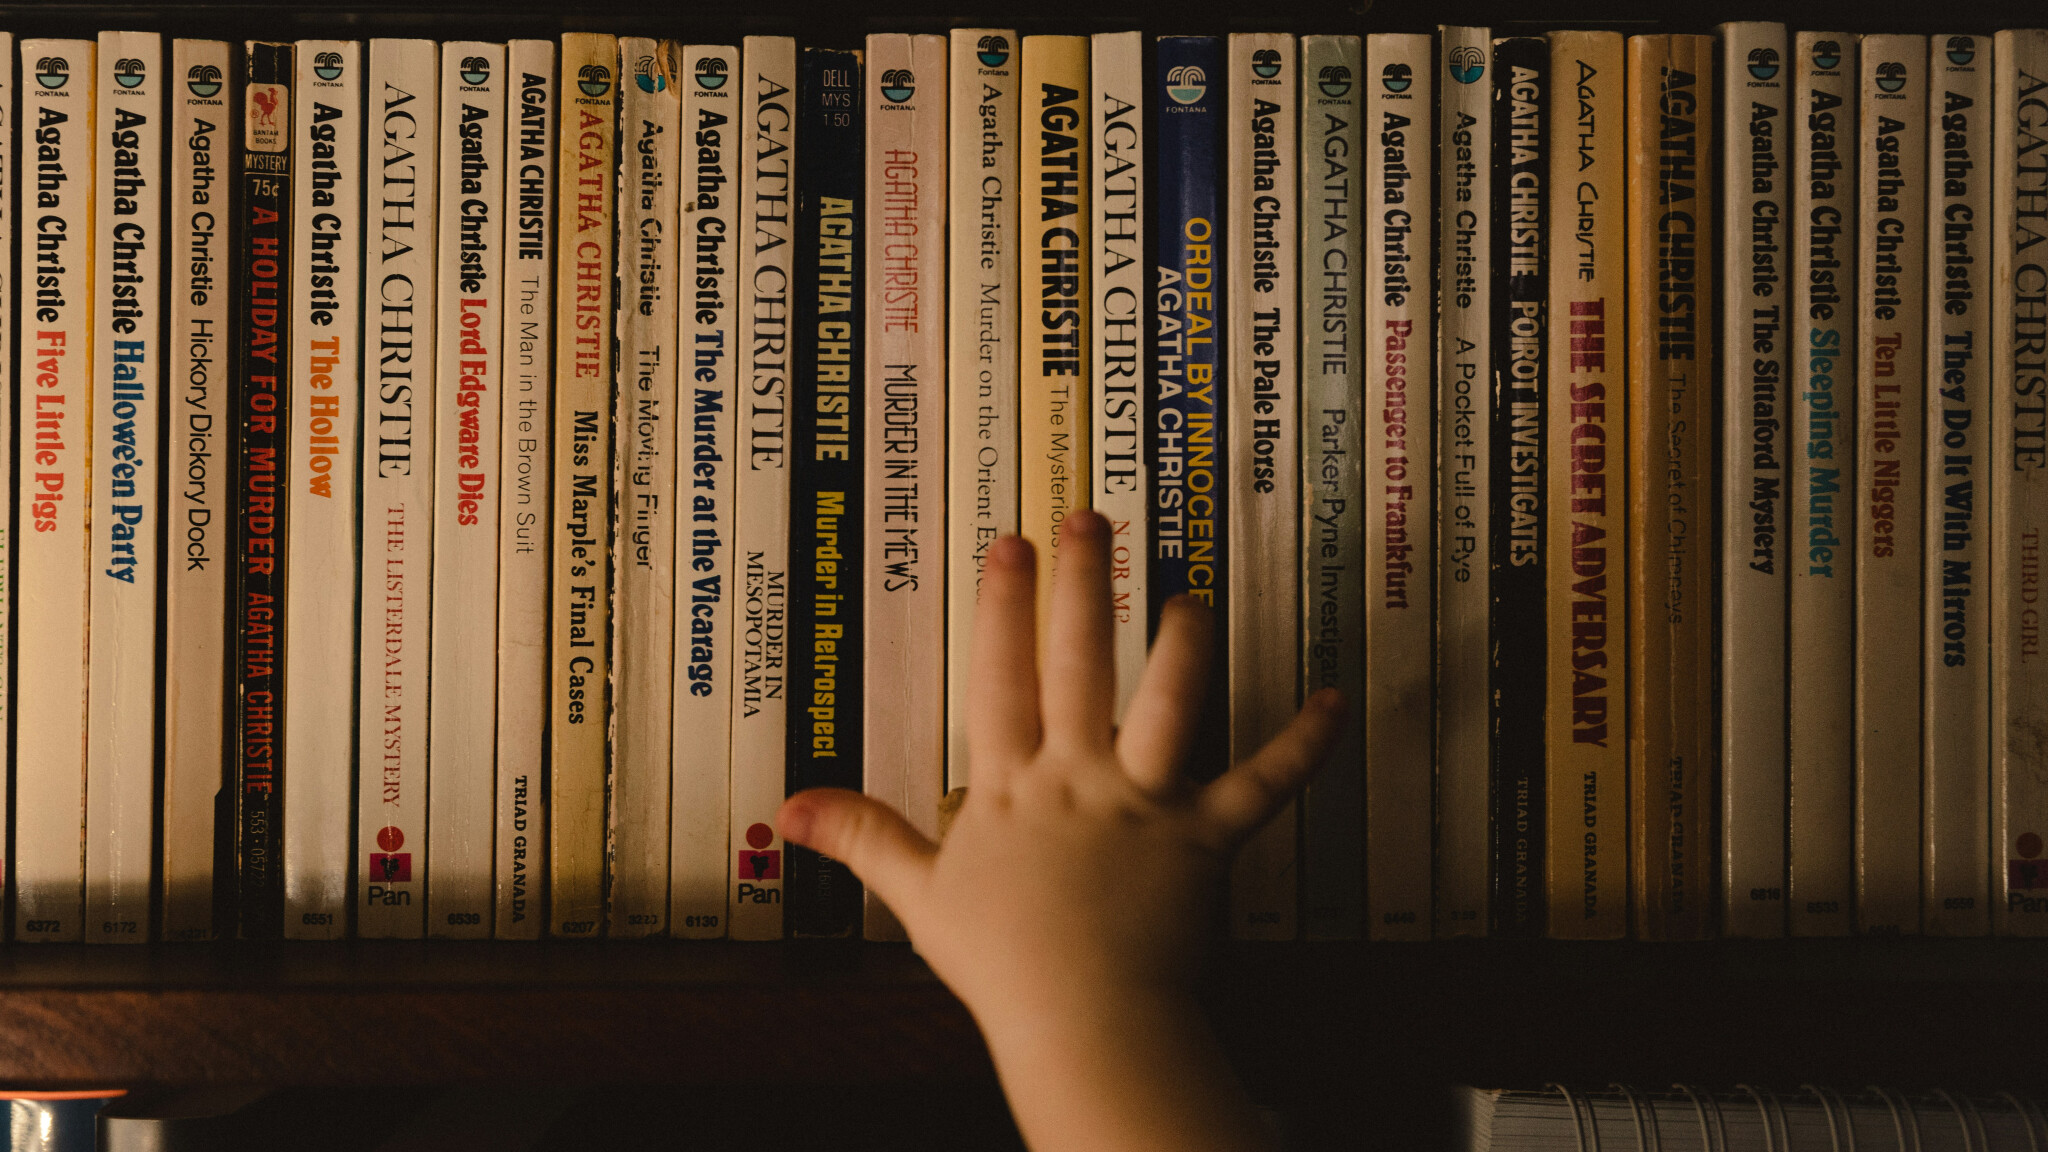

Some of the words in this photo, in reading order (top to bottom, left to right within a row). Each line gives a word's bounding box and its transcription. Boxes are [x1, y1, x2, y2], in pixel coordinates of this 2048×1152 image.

[520, 73, 545, 158] AGATHA
[575, 98, 611, 106] FONTANA
[822, 93, 850, 107] MYS
[823, 70, 850, 87] DELL
[978, 68, 1009, 76] Fontana
[1511, 66, 1538, 165] AGATHA
[1576, 60, 1597, 171] AGATHA
[35, 107, 67, 208] Agatha
[112, 108, 145, 215] Agatha
[190, 118, 216, 205] Agatha
[245, 154, 287, 171] MYSTERY
[310, 102, 343, 208] Agatha
[381, 81, 416, 265] AGATHA
[460, 103, 489, 195] Agatha
[579, 110, 601, 234] AGATHA
[695, 108, 727, 210] Agatha
[755, 73, 790, 257] AGATHA
[1104, 92, 1137, 278] AGATHA
[1252, 98, 1280, 190] Agatha
[1380, 112, 1410, 204] Agatha
[1750, 102, 1778, 194] Agatha
[1809, 89, 1841, 200] Agatha
[1875, 116, 1905, 212] Agatha
[1942, 91, 1973, 196] Agatha
[252, 206, 279, 225] A
[520, 165, 544, 260] CHRISTIE
[884, 150, 918, 237] AGATHA
[1510, 173, 1538, 277] CHRISTIE
[1576, 182, 1598, 282] CHRISTIE
[37, 215, 66, 323] Christie
[112, 223, 144, 334] Christie
[191, 212, 215, 306] Christie
[310, 213, 341, 326] Christie
[460, 199, 488, 293] Christie
[696, 216, 725, 325] Christie
[820, 196, 853, 314] AGATHA
[884, 244, 918, 333] CHRISTIE
[1185, 218, 1211, 355] ORDEAL
[1254, 196, 1280, 293] Christie
[1383, 210, 1411, 307] Christie
[1751, 201, 1779, 297] Christie
[1810, 206, 1841, 320] Christie
[1874, 218, 1904, 320] Christie
[1944, 204, 1973, 316] Christie
[250, 238, 278, 361] HOLIDAY
[460, 299, 487, 355] Lord
[521, 276, 539, 315] The
[576, 241, 599, 378] CHRISTIE
[1158, 266, 1181, 399] AGATHA
[1254, 308, 1279, 355] The
[1570, 298, 1605, 372] THE
[1753, 305, 1778, 353] The
[35, 330, 66, 388] Five
[186, 320, 213, 410] Hickory
[310, 335, 339, 389] The
[380, 274, 414, 478] CHRISTIE
[520, 322, 537, 365] Man
[520, 375, 537, 392] in
[694, 330, 724, 380] The
[751, 265, 787, 471] CHRISTIE
[1187, 364, 1212, 405] BY
[1254, 361, 1279, 414] Pale
[1380, 320, 1412, 450] Passenger
[1510, 302, 1538, 392] POIROT
[1874, 333, 1902, 377] Ten
[1939, 331, 1973, 401] They
[35, 395, 65, 466] Little
[112, 340, 145, 497] Hallowe'en
[250, 375, 277, 433] FOR
[458, 361, 486, 468] Edgware
[519, 400, 536, 432] the
[815, 320, 851, 461] CHRISTIE
[884, 365, 917, 453] MURDER
[1103, 286, 1137, 494] CHRISTIE
[1753, 359, 1779, 470] Sittaford
[1802, 328, 1840, 459] Sleeping
[1874, 384, 1901, 453] Little
[1944, 409, 1972, 449] Do
[185, 414, 211, 504] Dickory
[309, 395, 338, 497] Hollow
[517, 440, 535, 504] Brown
[573, 410, 598, 466] Miss
[693, 388, 723, 490] Murder
[884, 459, 918, 478] IN
[1159, 408, 1182, 558] CHRISTIE
[1254, 420, 1279, 493] Horse
[1384, 456, 1410, 479] to
[1570, 382, 1605, 516] SECRET
[1944, 455, 1972, 476] It
[33, 472, 63, 532] Pigs
[248, 448, 276, 574] MURDER
[387, 503, 404, 551] THE
[458, 473, 484, 525] Dies
[568, 474, 596, 576] Marple's
[693, 499, 715, 524] at
[885, 483, 918, 522] THE
[1113, 521, 1130, 536] N
[1510, 403, 1538, 566] INVESTIGATES
[1750, 477, 1779, 574] Mystery
[1809, 467, 1840, 578] Murder
[1872, 460, 1901, 558] Niggers
[1944, 480, 1972, 551] With
[106, 504, 142, 584] Party
[186, 509, 210, 571] Dock
[516, 512, 535, 554] Suit
[693, 529, 721, 571] the
[816, 491, 844, 588] Murder
[884, 529, 918, 592] MEWS
[1113, 546, 1130, 579] OR
[1384, 485, 1412, 609] Frankfurt
[247, 592, 274, 677] AGATHA
[384, 559, 403, 698] LISTERDALE
[570, 586, 595, 647] Final
[689, 576, 721, 697] Vicarage
[744, 551, 762, 718] MESOPOTAMIA
[766, 571, 783, 668] MURDER
[815, 594, 843, 616] in
[1571, 521, 1607, 747] ADVERSARY
[1943, 560, 1971, 667] Mirrors
[568, 657, 593, 724] Cases
[765, 675, 781, 699] IN
[808, 623, 843, 758] Retrospect
[246, 690, 273, 794] CHRISTIE
[383, 704, 401, 807] MYSTERY
[514, 775, 527, 831] TRIAD
[1584, 772, 1596, 827] TRIAD
[368, 886, 410, 905] Pan
[513, 836, 526, 923] GRANADA
[738, 883, 780, 904] Pan
[1584, 833, 1597, 919] GRANADA
